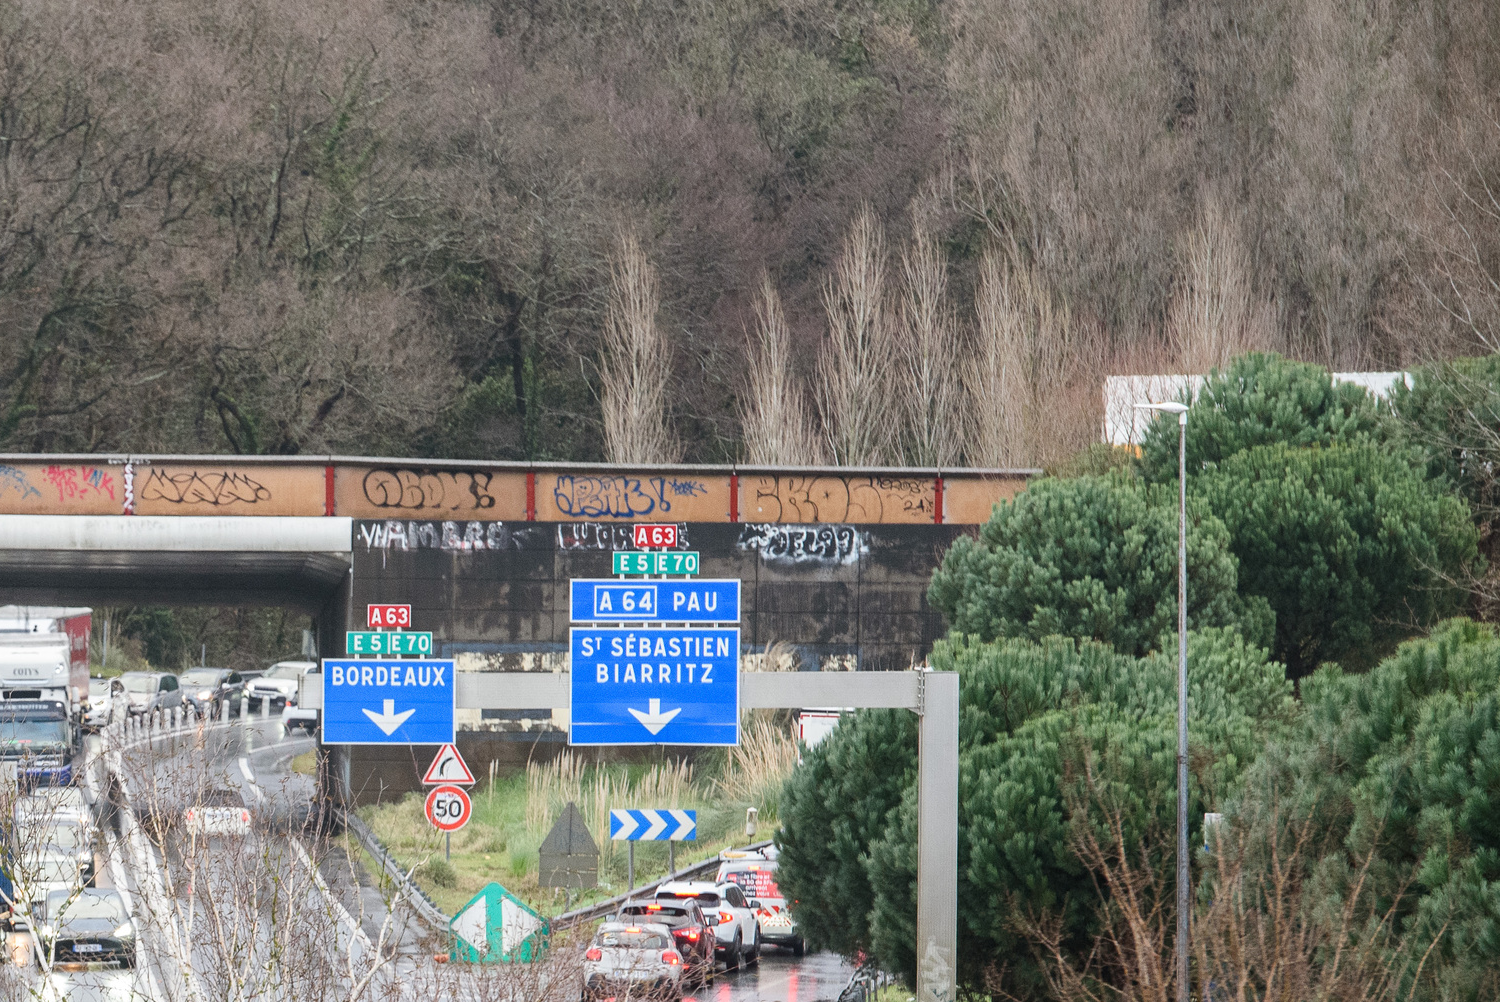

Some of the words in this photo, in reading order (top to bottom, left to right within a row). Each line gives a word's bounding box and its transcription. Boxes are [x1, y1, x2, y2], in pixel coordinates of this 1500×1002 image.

[636, 527, 649, 545] A
[652, 526, 675, 545] 63
[621, 555, 631, 572] E
[638, 555, 649, 572] 5
[659, 555, 668, 572] E
[673, 555, 696, 572] 70
[600, 591, 613, 611] A
[622, 591, 653, 612] 64
[673, 591, 718, 612] PAU
[371, 607, 382, 625] A
[385, 606, 408, 625] 63
[354, 634, 363, 651] E
[370, 634, 382, 651] 5
[391, 634, 401, 651] E
[406, 634, 429, 651] 70
[611, 633, 730, 657] SÉBASTIEN
[332, 667, 446, 688] BORDEAUX
[596, 663, 714, 684] BIARRITZ
[435, 799, 462, 818] 50
